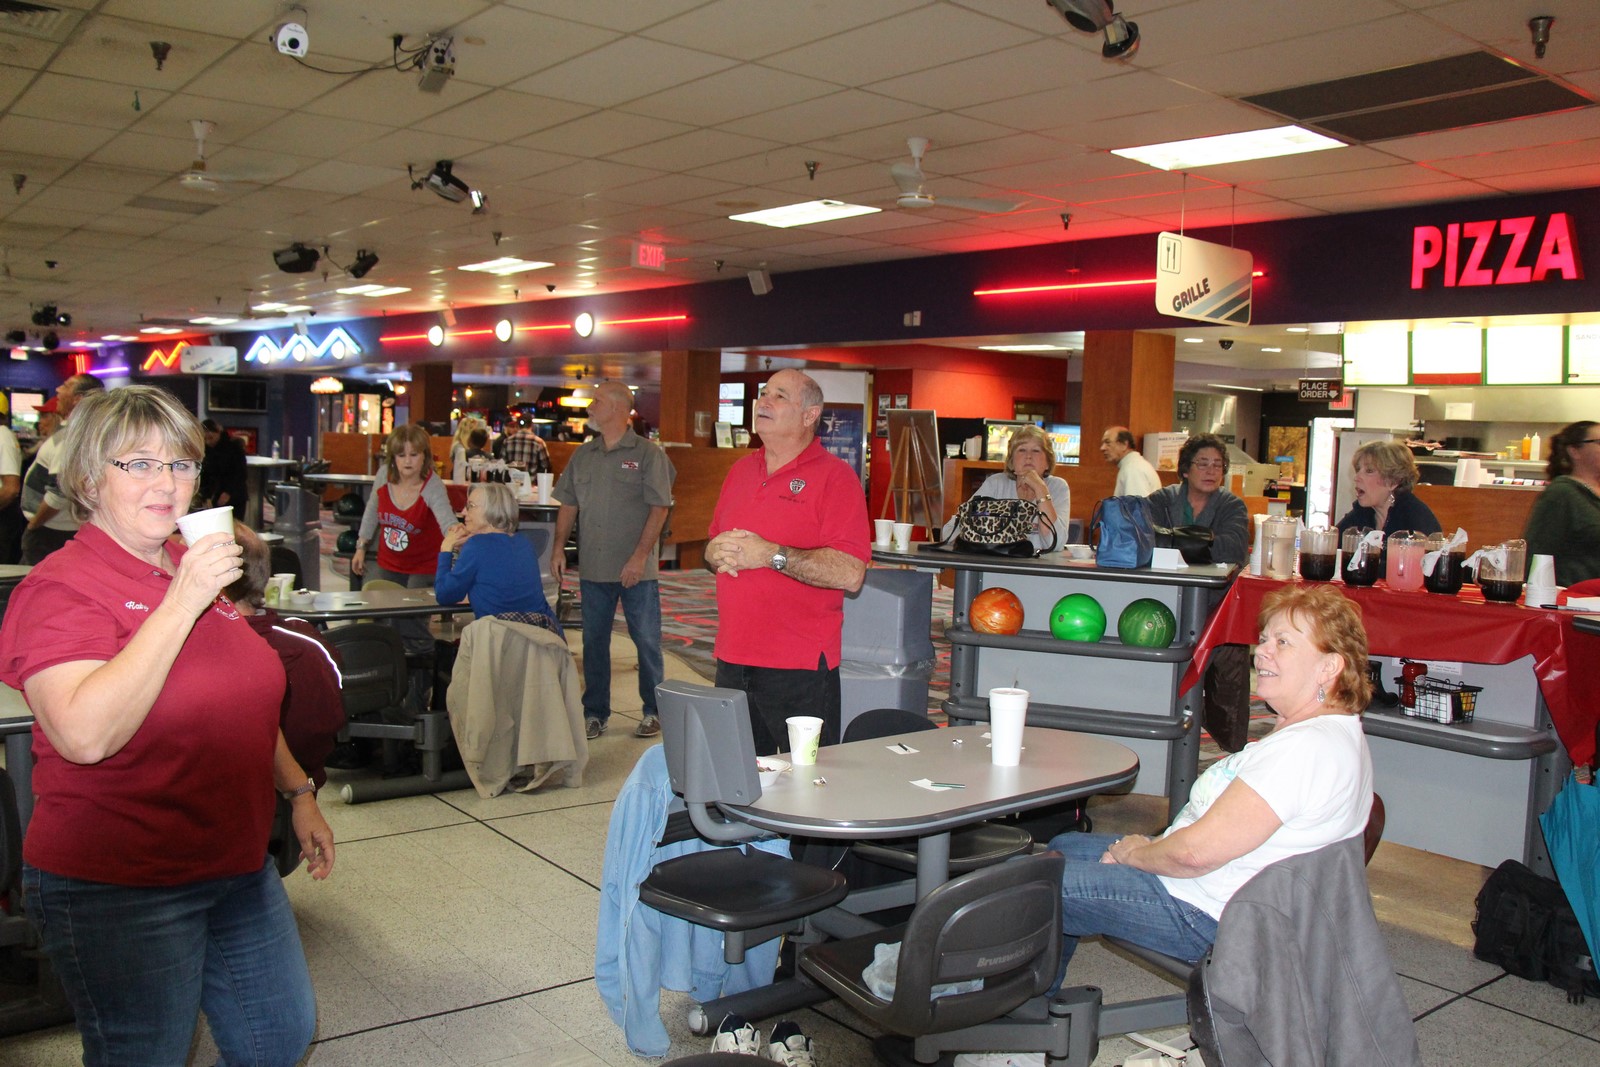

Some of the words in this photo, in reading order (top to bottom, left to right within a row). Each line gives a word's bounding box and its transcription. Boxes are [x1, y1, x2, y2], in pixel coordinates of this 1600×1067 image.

[639, 244, 662, 267] EXIT
[1411, 212, 1581, 289] PIZZA
[1173, 277, 1210, 312] GRILLE
[1300, 390, 1328, 398] ORDER
[1301, 382, 1328, 390] PLACE
[976, 944, 1026, 968] Brunswick
